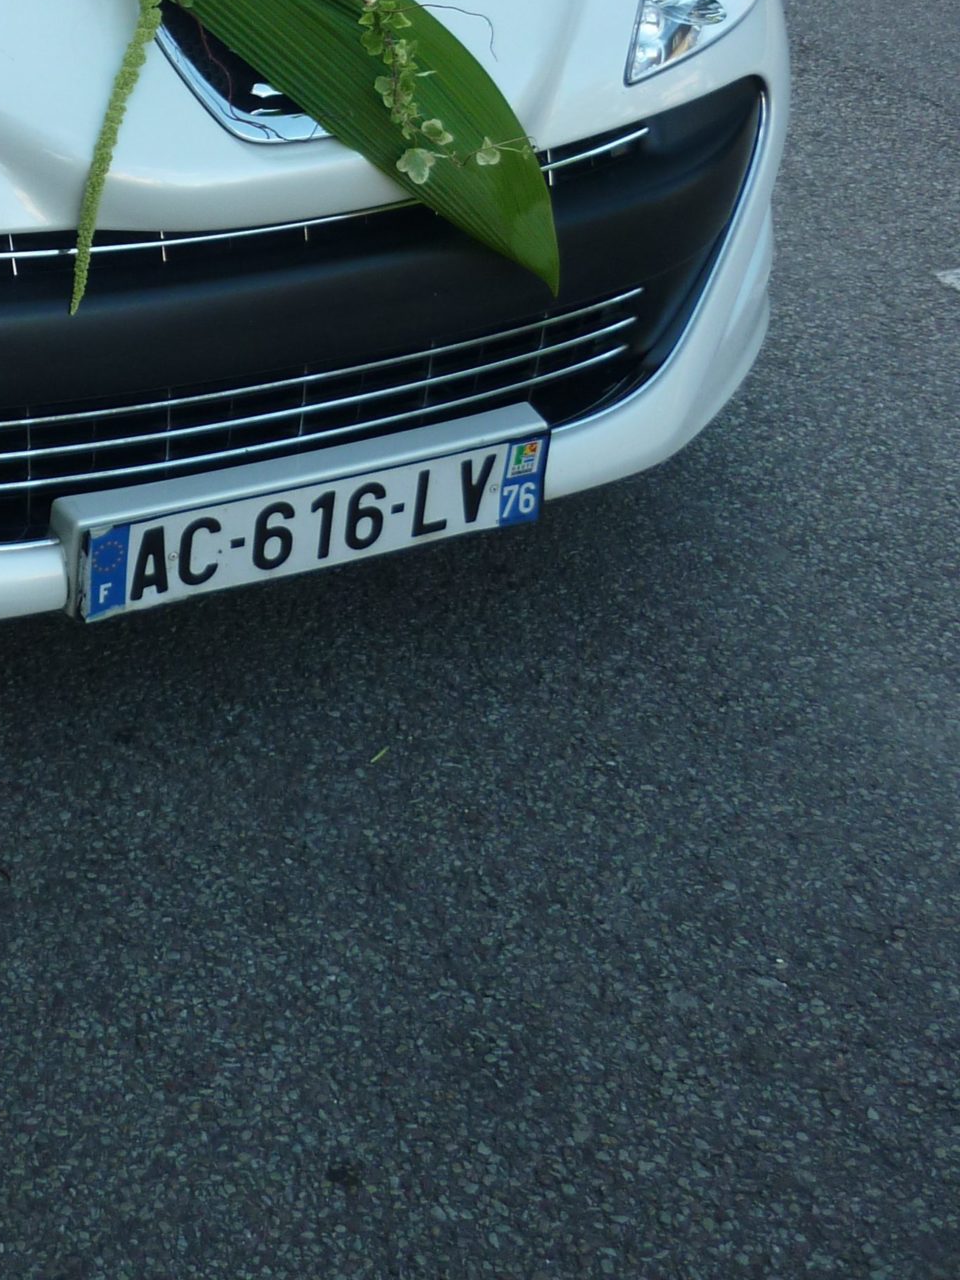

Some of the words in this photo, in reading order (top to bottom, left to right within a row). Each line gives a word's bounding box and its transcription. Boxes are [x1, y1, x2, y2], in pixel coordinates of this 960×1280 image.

[502, 482, 536, 518] 76
[130, 454, 497, 601] AC-616-LV
[99, 582, 112, 604] F
